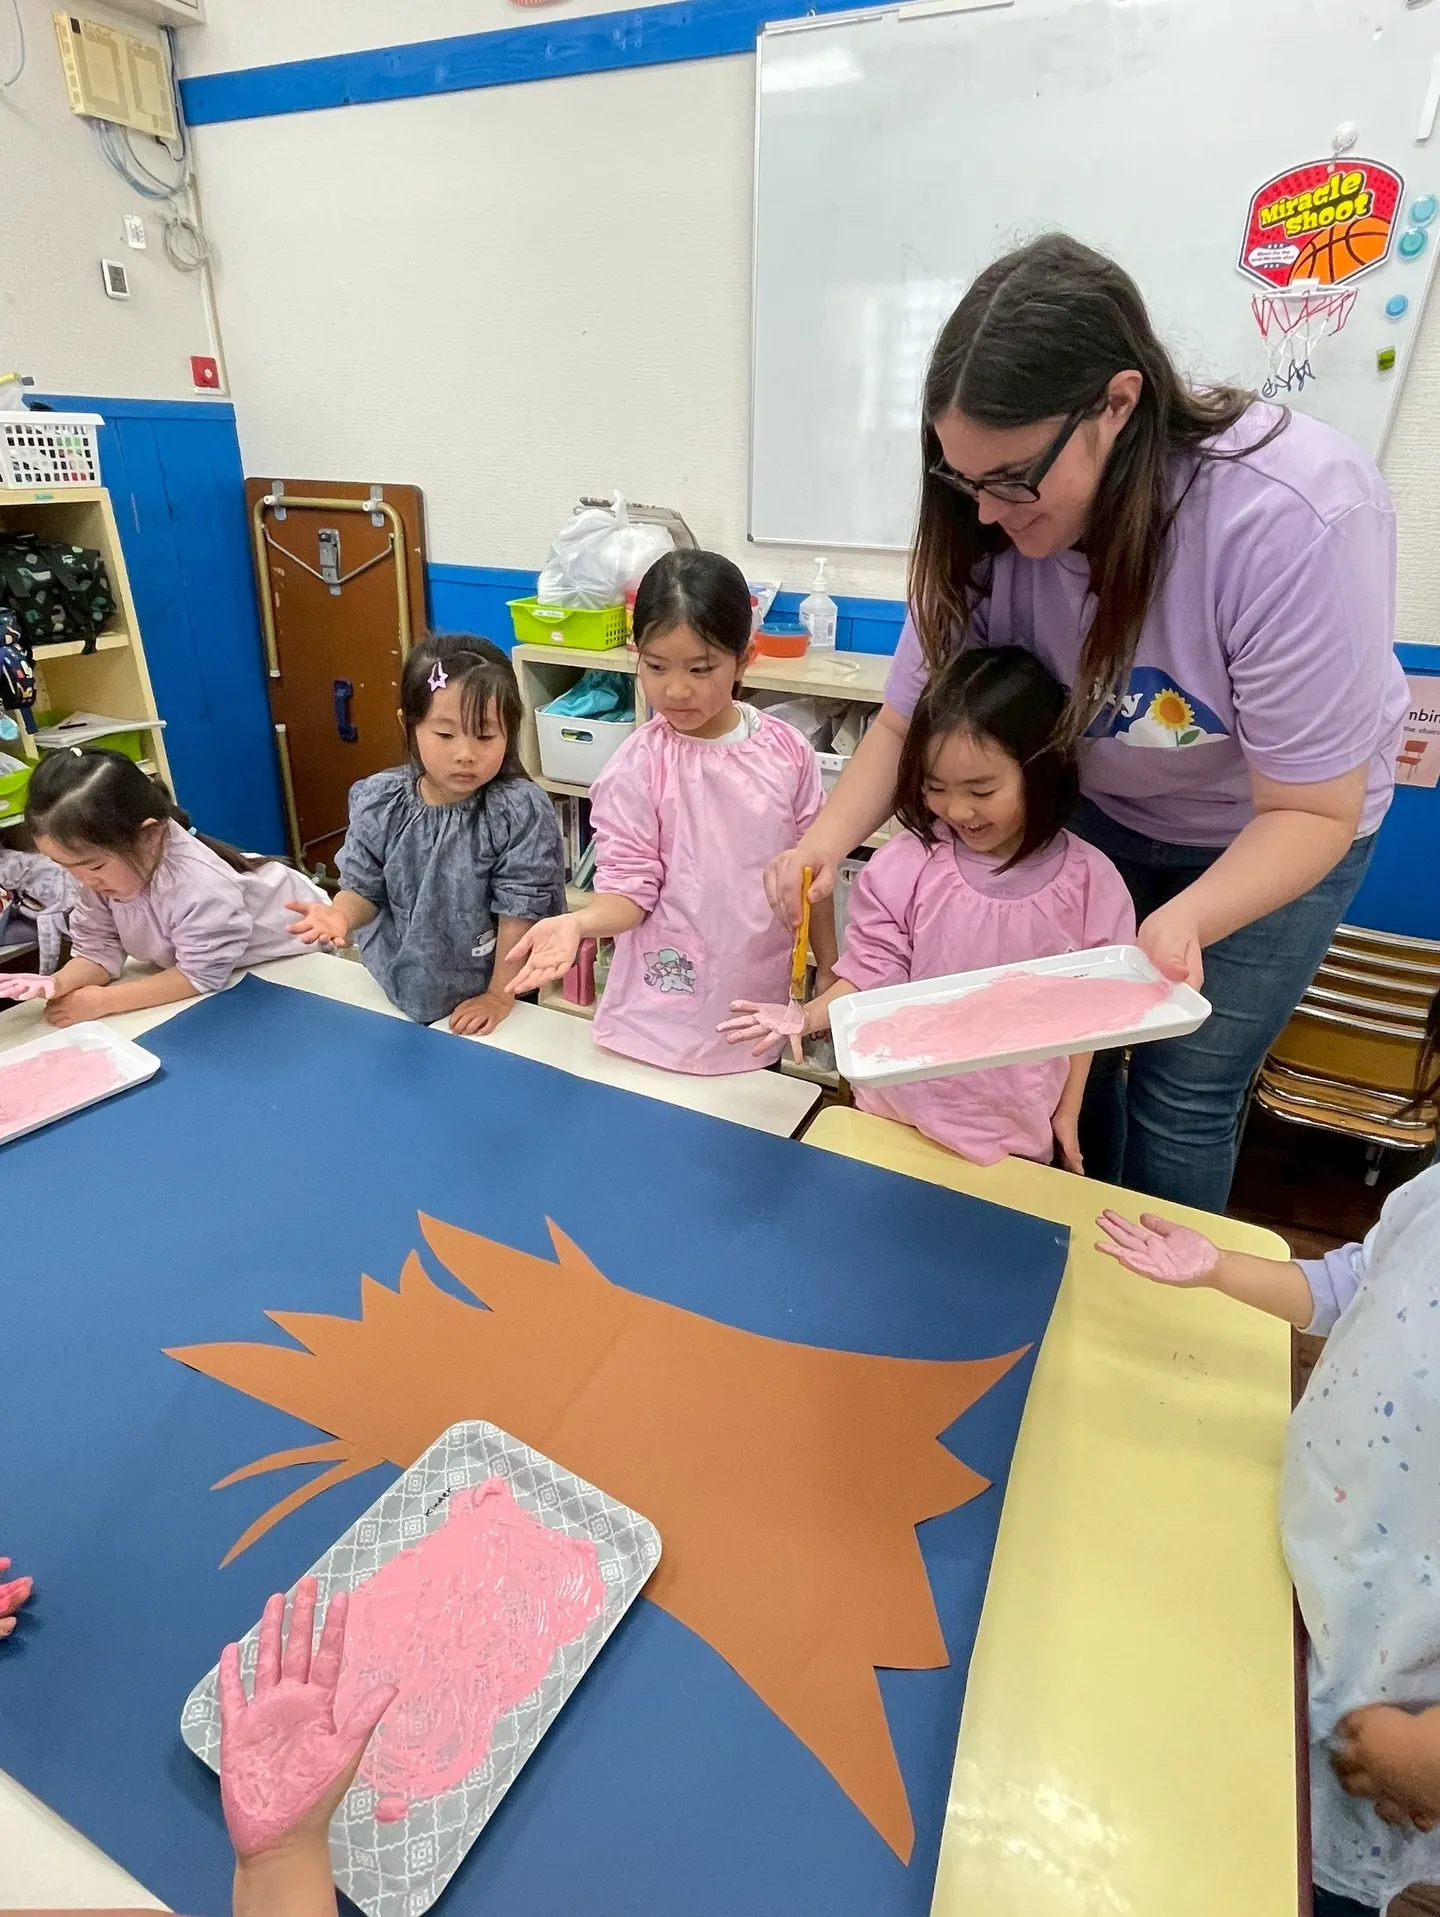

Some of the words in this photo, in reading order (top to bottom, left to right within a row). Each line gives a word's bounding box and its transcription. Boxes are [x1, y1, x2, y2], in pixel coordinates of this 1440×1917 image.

[1259, 171, 1364, 226] Miracle
[1285, 191, 1370, 236] Shoot
[425, 1487, 451, 1517] Kinder
